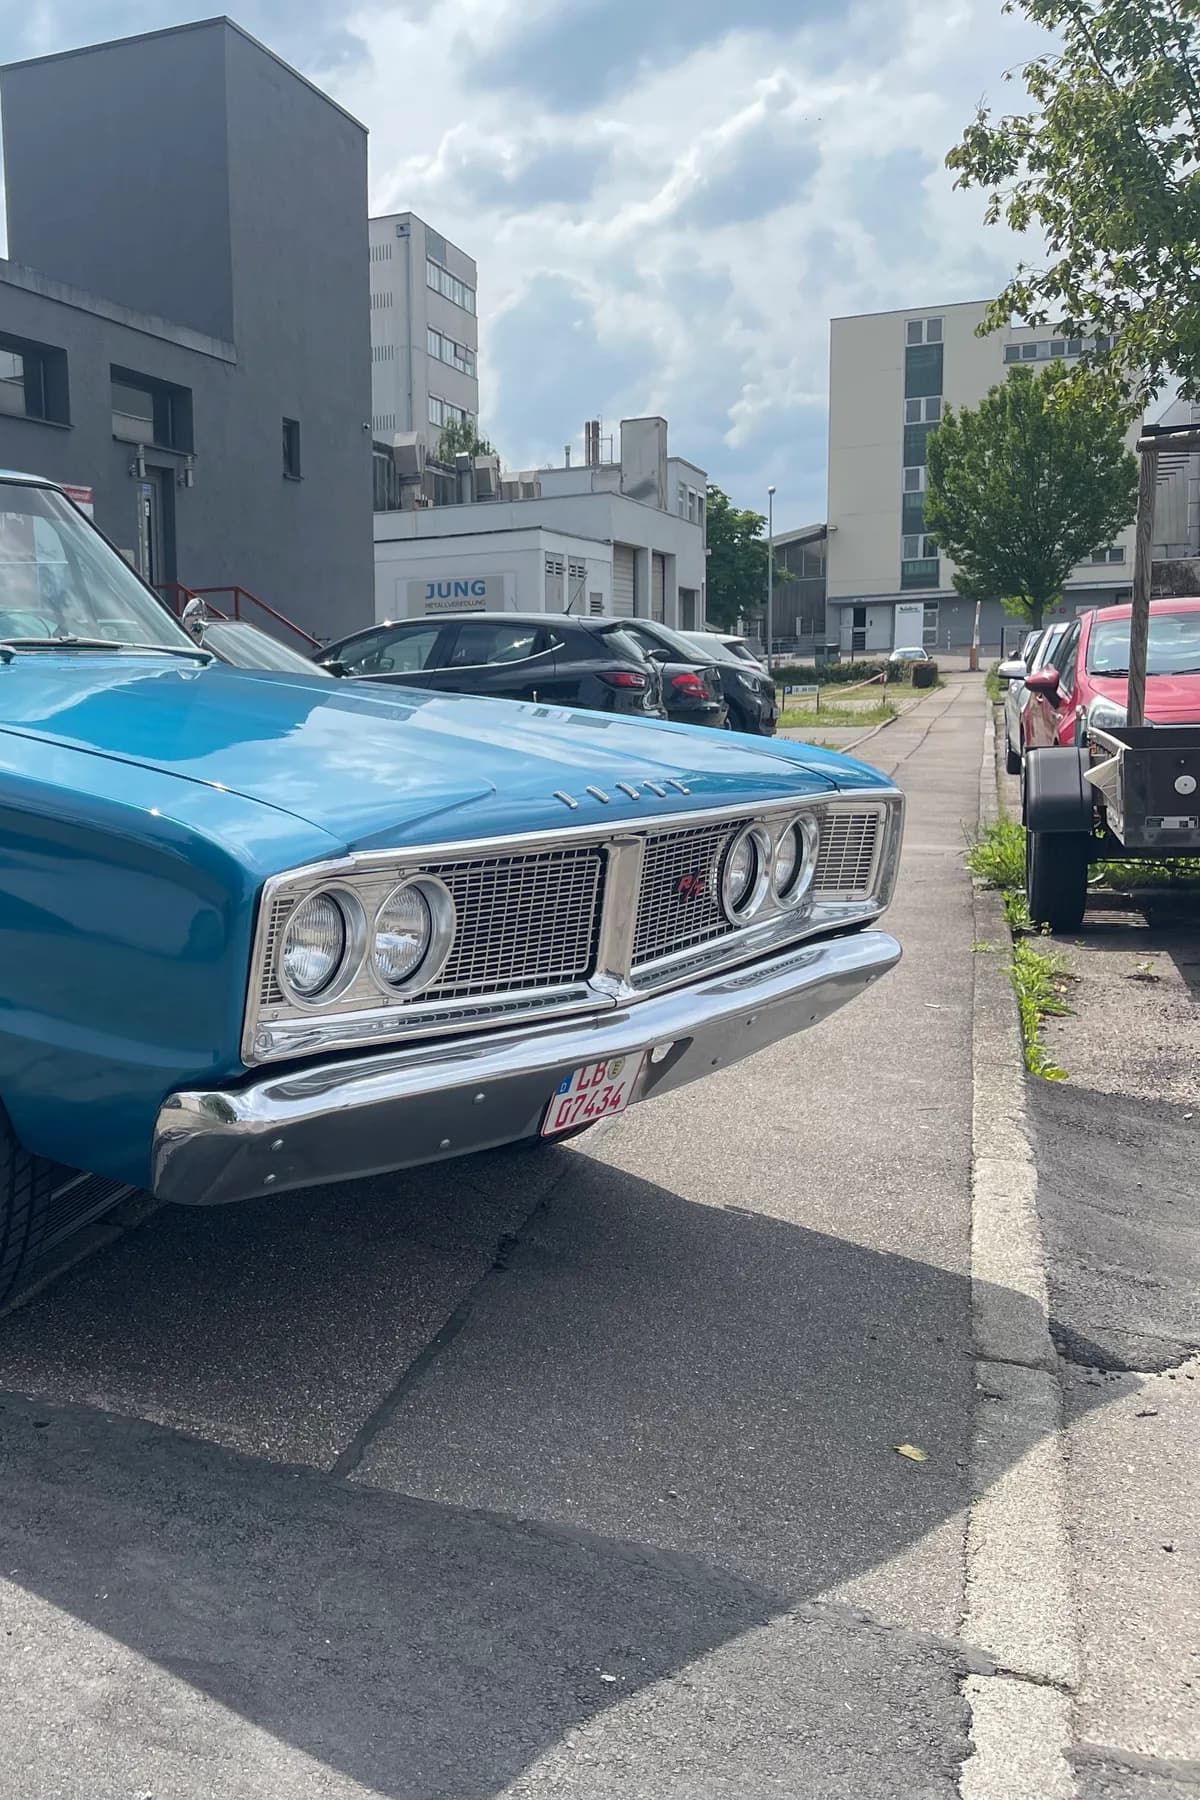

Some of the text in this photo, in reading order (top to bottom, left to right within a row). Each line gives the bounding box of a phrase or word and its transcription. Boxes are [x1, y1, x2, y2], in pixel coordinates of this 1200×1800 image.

[425, 580, 486, 600] JUNG
[560, 1083, 568, 1092] D
[576, 1060, 609, 1092] LB
[555, 1081, 626, 1128] 07434
